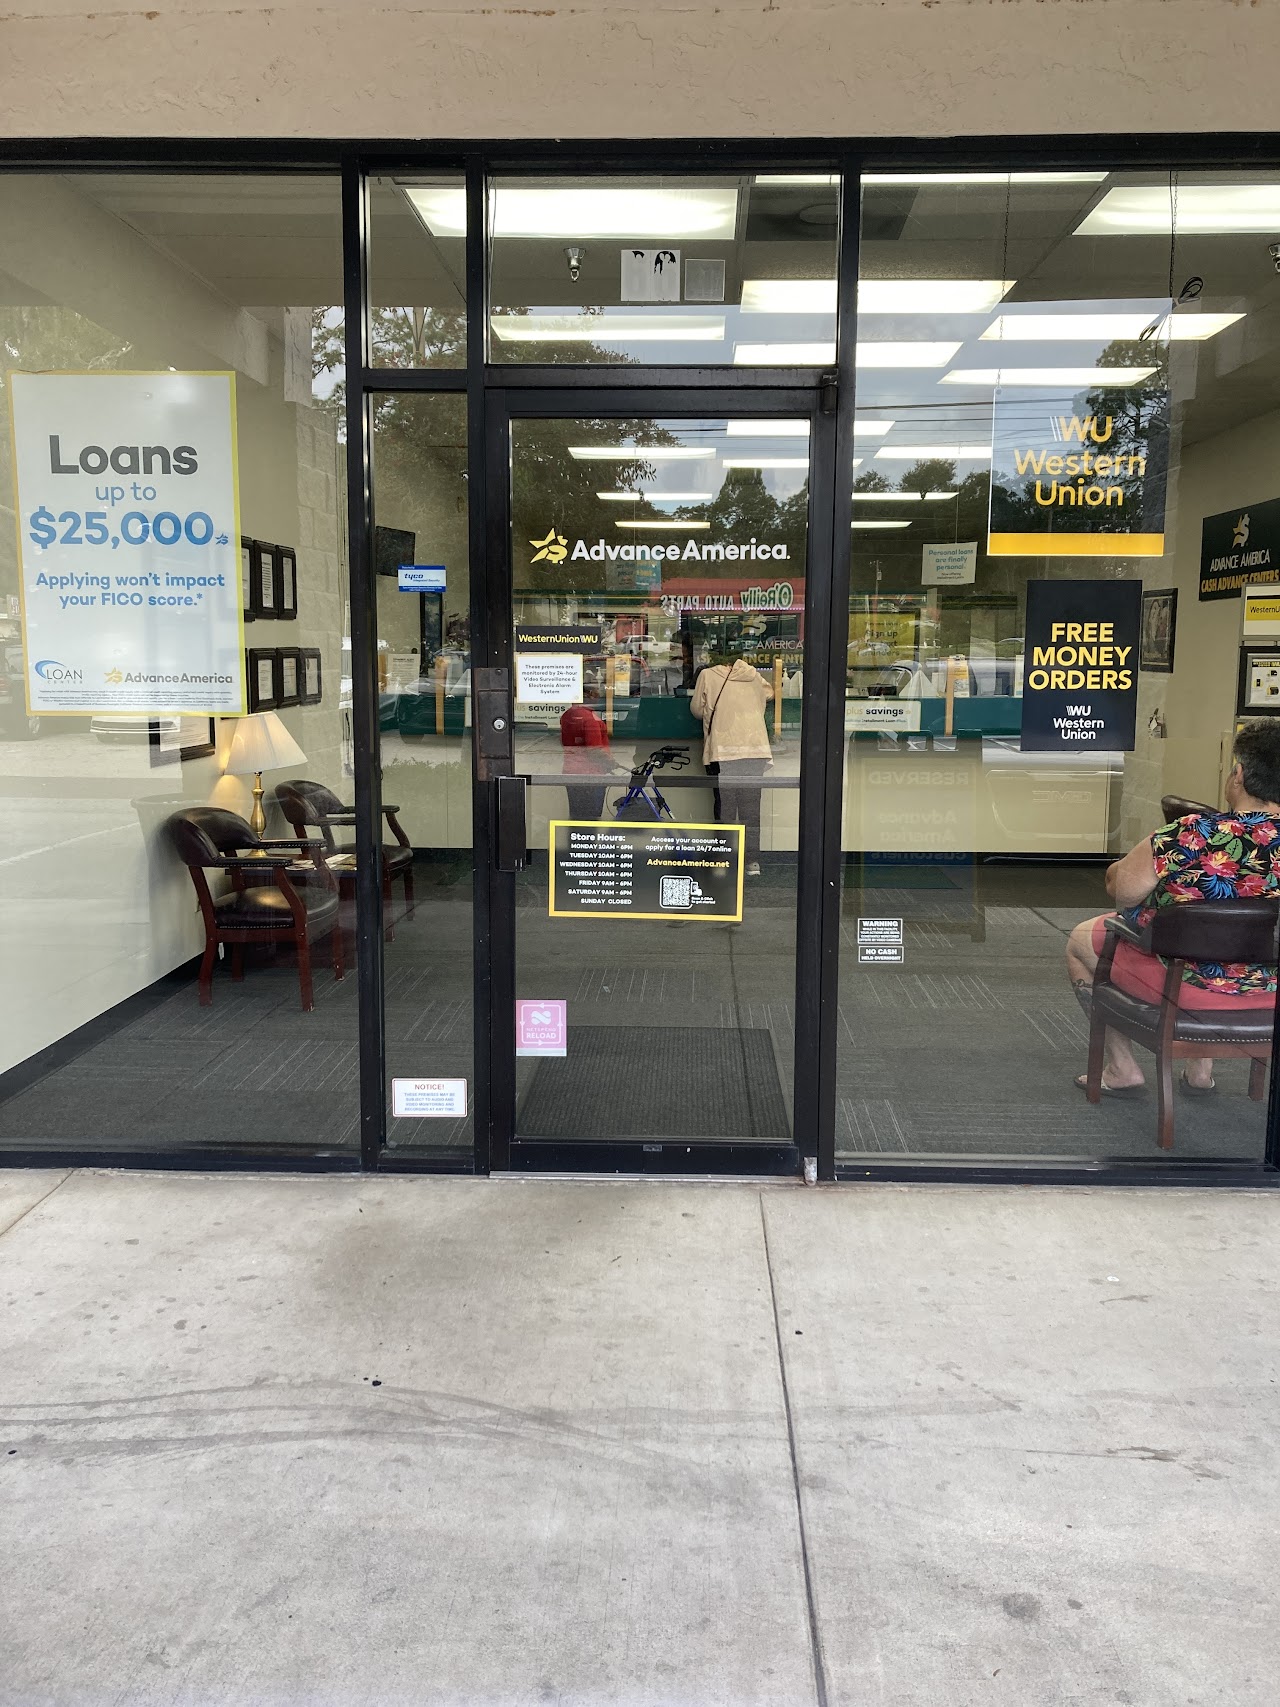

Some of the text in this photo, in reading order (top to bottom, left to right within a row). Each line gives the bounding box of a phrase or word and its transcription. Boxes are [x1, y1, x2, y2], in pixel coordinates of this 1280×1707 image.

[1051, 416, 1113, 442] WU
[49, 434, 198, 476] Loans
[1014, 448, 1147, 476] Western
[96, 482, 156, 506] up to
[1036, 478, 1124, 506] Union
[29, 506, 214, 550] $25,000
[1210, 548, 1270, 572] ADVANCE AMERICA
[36, 572, 225, 590] Applying won't impact
[1202, 568, 1280, 593] CASH ADVANCE CENTERS
[59, 594, 97, 610] your
[101, 593, 144, 606] FICO
[518, 634, 580, 643] WesternUnion
[1052, 622, 1114, 643] FREE
[756, 640, 804, 650] AMERICA
[1032, 646, 1132, 666] MONEY
[46, 669, 83, 680] LOAN
[1028, 670, 1132, 690] ORDERS
[528, 704, 566, 714] savings
[846, 707, 904, 717] plus savings
[1066, 705, 1092, 716] WU
[1053, 718, 1104, 728] Western
[1061, 728, 1096, 739] Union
[647, 859, 730, 868] AdvanceAmerica.net
